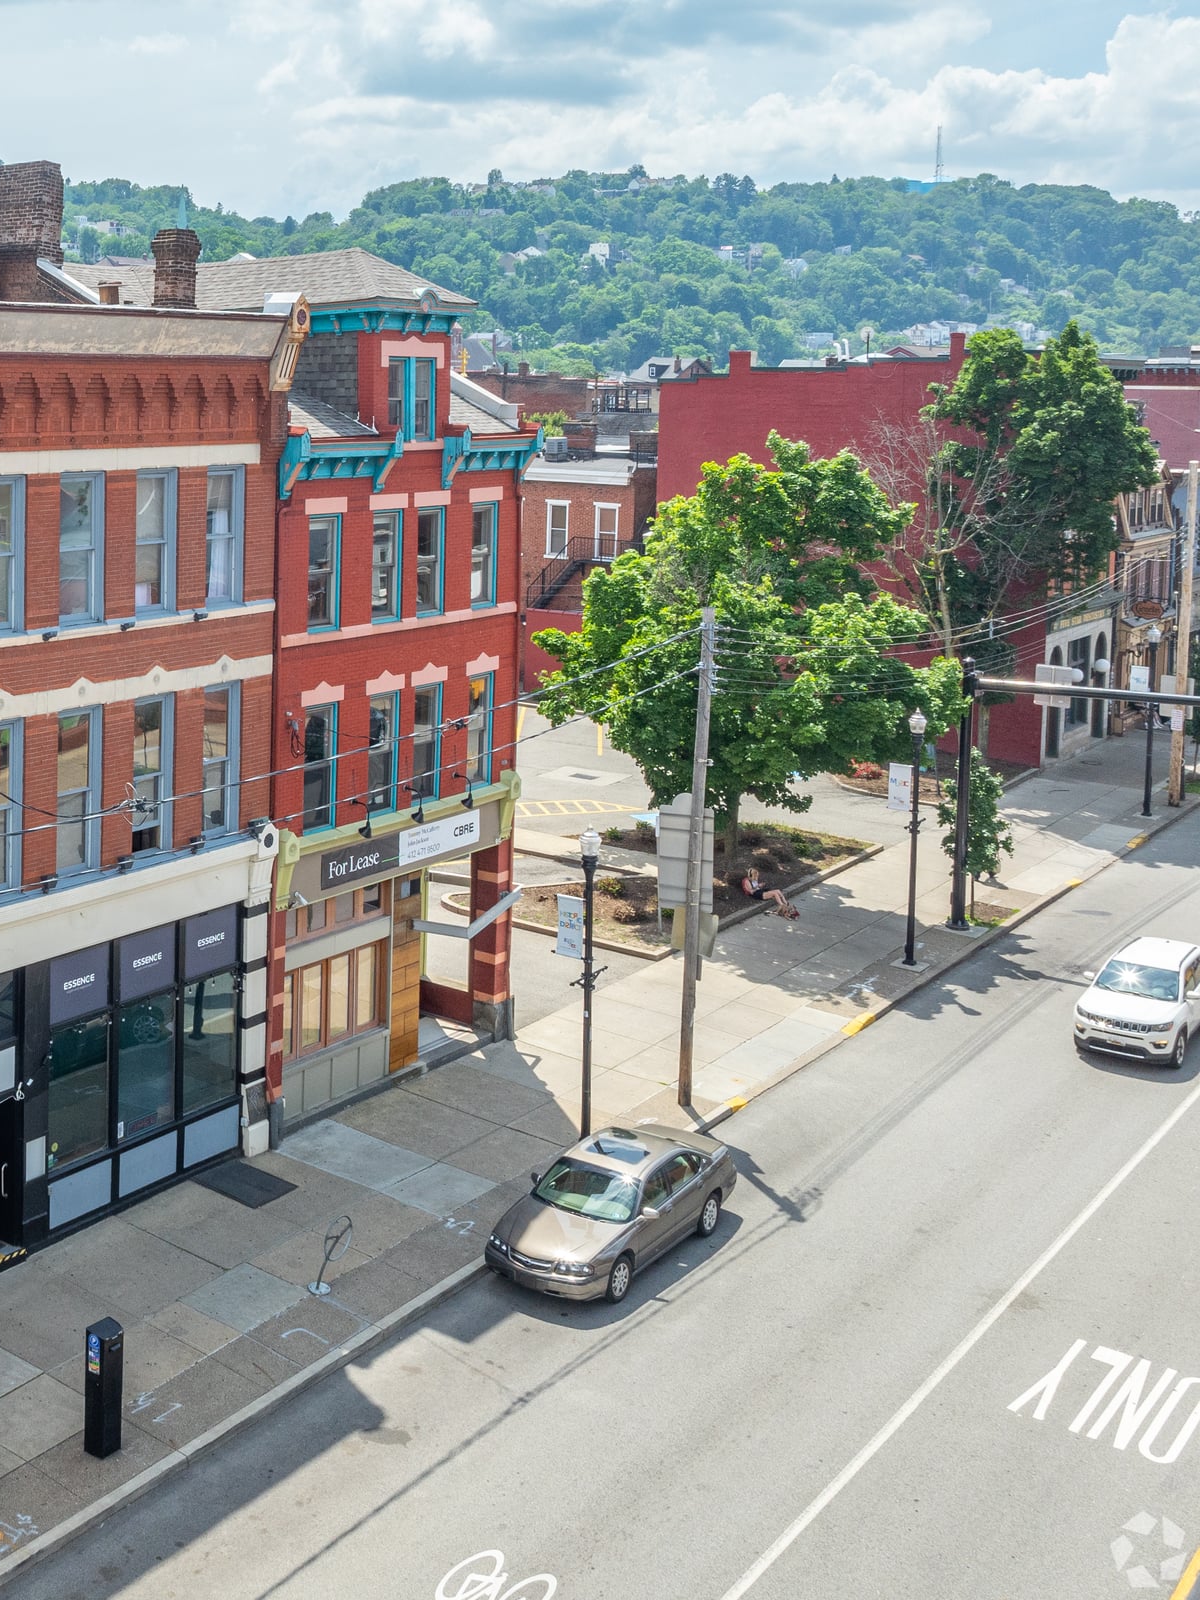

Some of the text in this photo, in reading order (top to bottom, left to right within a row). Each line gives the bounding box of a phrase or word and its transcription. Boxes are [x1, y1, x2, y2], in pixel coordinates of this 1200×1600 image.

[453, 822, 474, 837] CBRE
[328, 852, 380, 879] For Lease
[197, 931, 225, 948] ESSENCE
[132, 951, 163, 969] ESSENCE
[63, 973, 96, 991] ESSENCE
[1006, 1338, 1200, 1464] ONLY
